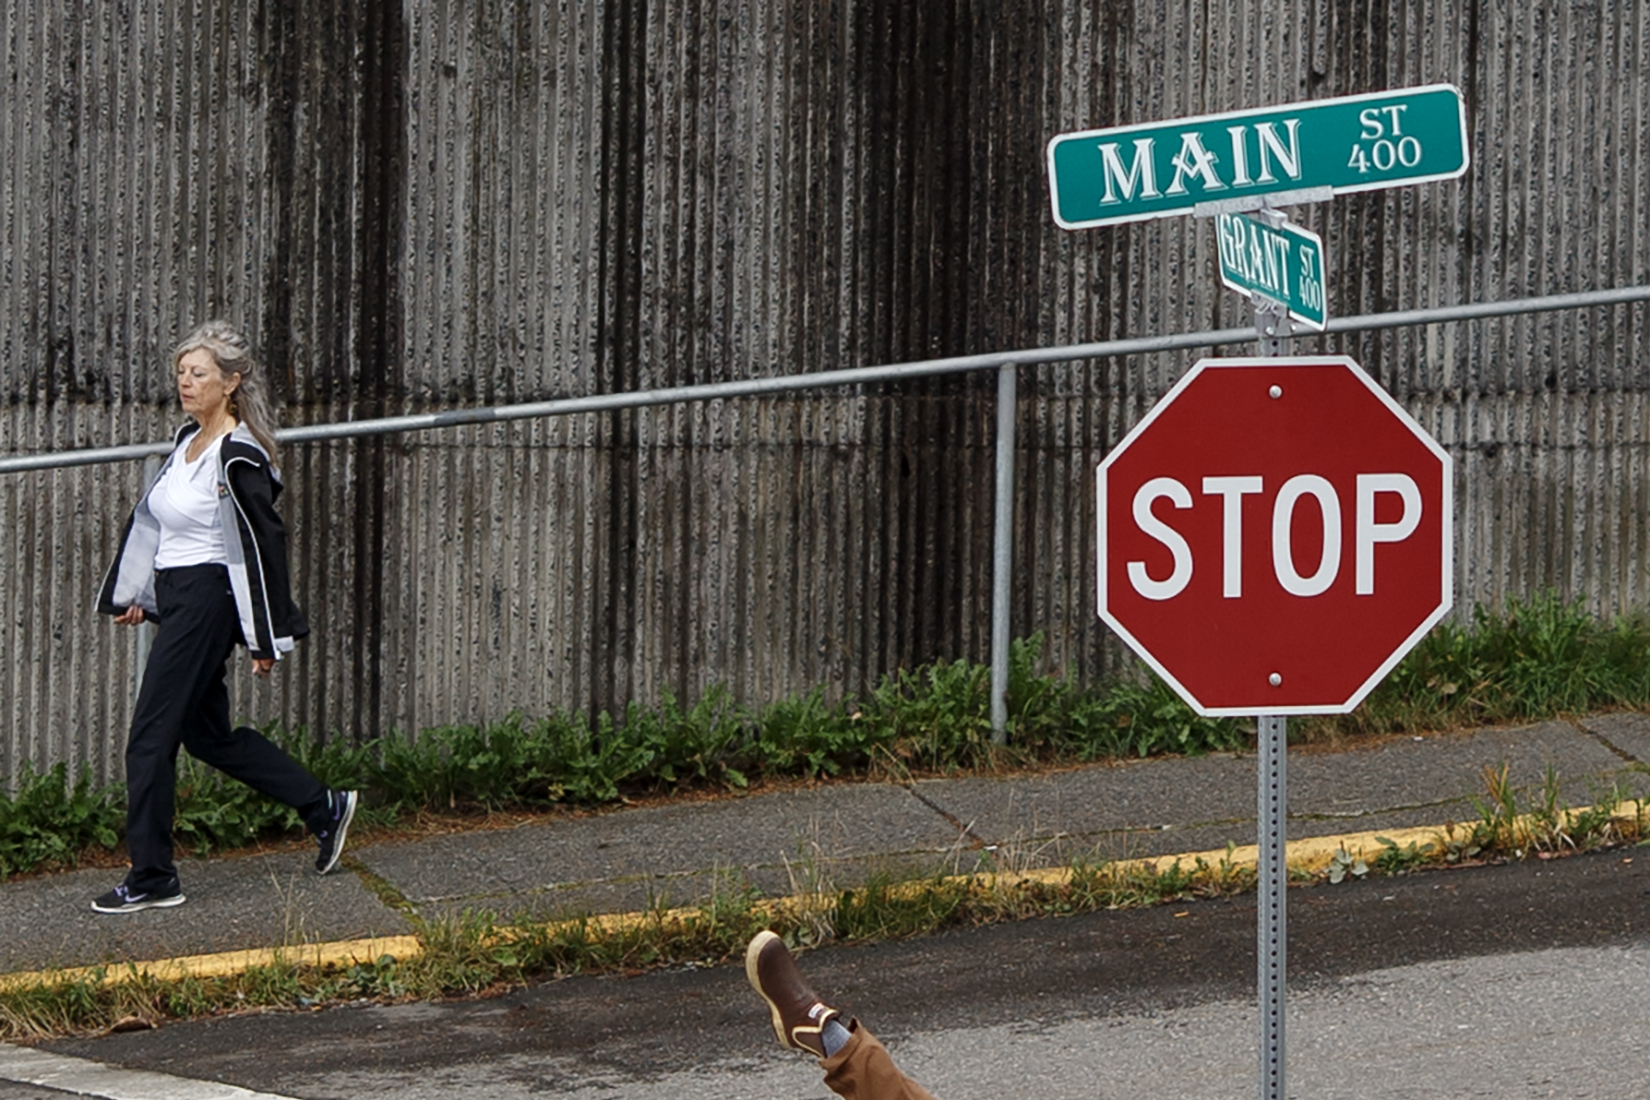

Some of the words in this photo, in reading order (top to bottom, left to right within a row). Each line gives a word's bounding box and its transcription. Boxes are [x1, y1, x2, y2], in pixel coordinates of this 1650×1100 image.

[1098, 118, 1302, 204] MAIN
[1359, 104, 1408, 139] ST
[1347, 136, 1422, 173] 400
[1220, 213, 1290, 300] GRANT
[1300, 244, 1314, 279] ST
[1299, 275, 1320, 312] 400
[1127, 473, 1423, 600] STOP
